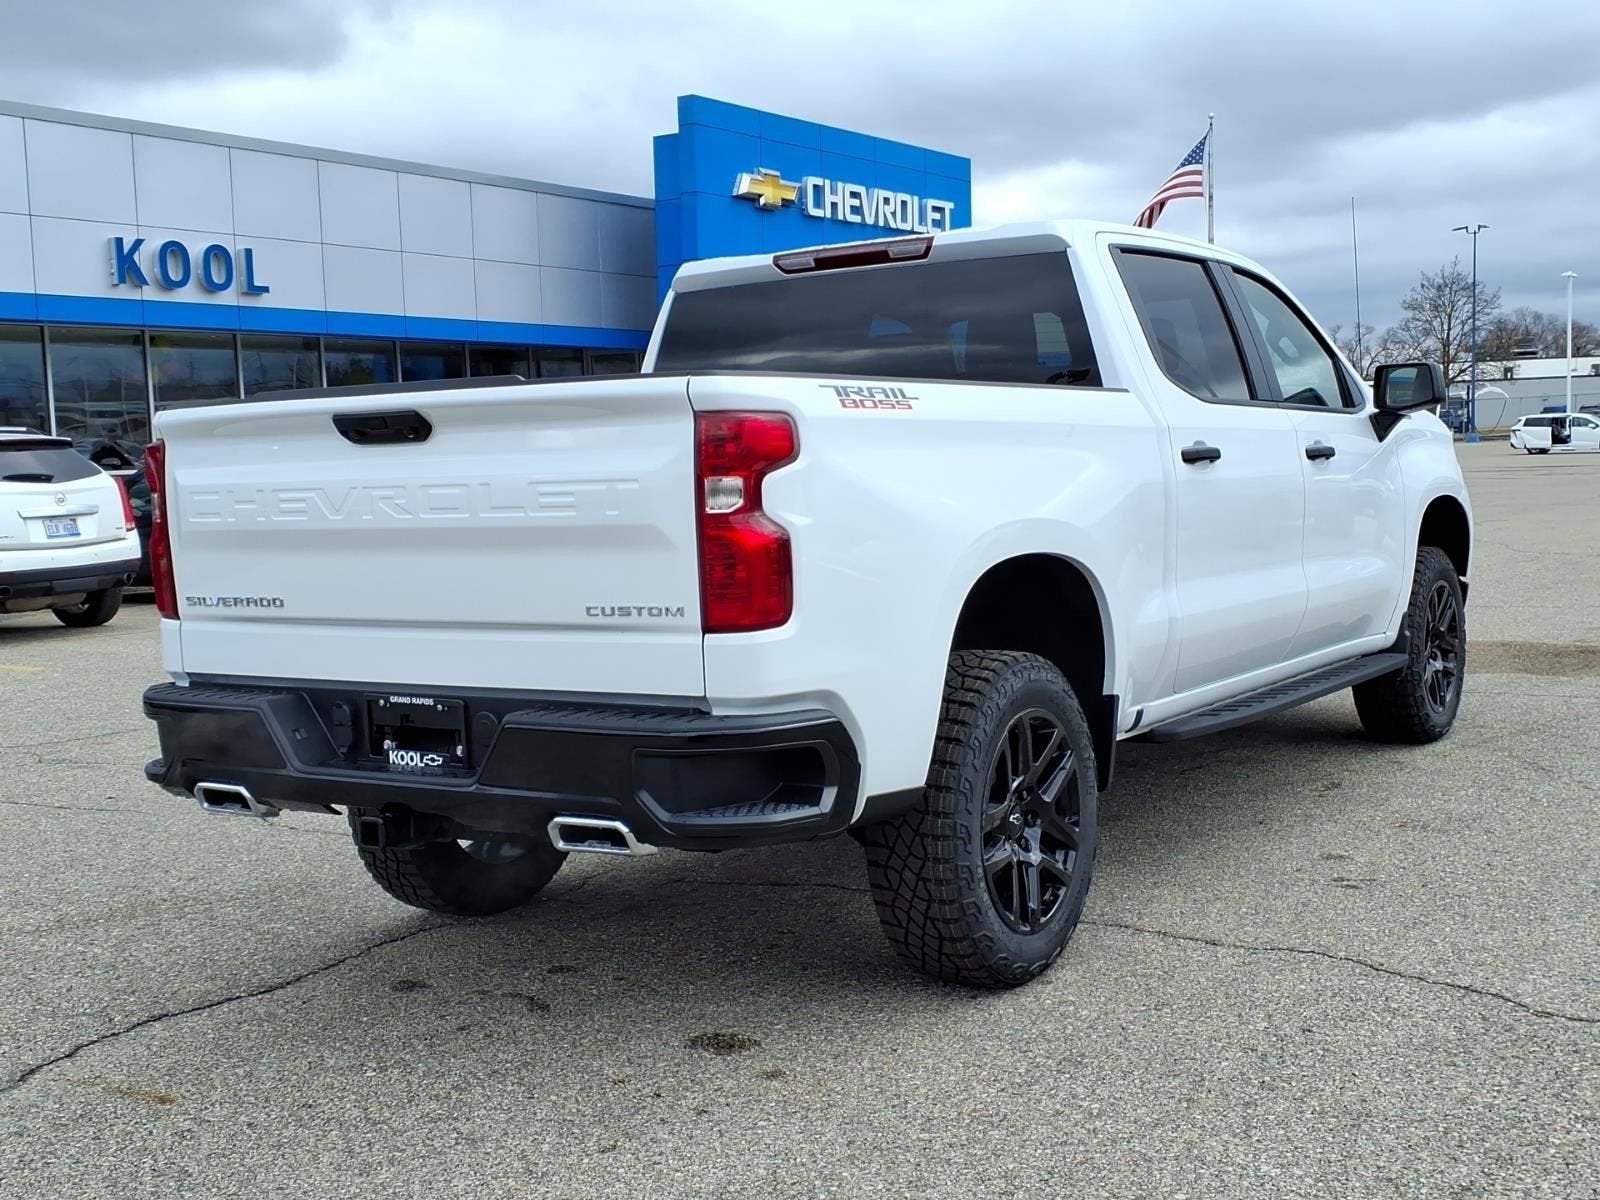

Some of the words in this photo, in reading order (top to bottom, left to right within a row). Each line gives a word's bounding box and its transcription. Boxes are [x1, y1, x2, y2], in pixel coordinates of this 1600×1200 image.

[802, 176, 954, 233] CHEVROLET
[108, 236, 270, 295] KOOL
[818, 384, 919, 400] TRAIL
[839, 398, 912, 410] BOSS
[188, 478, 640, 523] CHEVROLET
[185, 596, 285, 608] SILVERADO
[585, 606, 685, 618] CUSTOM
[390, 696, 411, 704] GRAND
[411, 697, 434, 706] RAPIDS
[389, 750, 425, 767] KOOL
